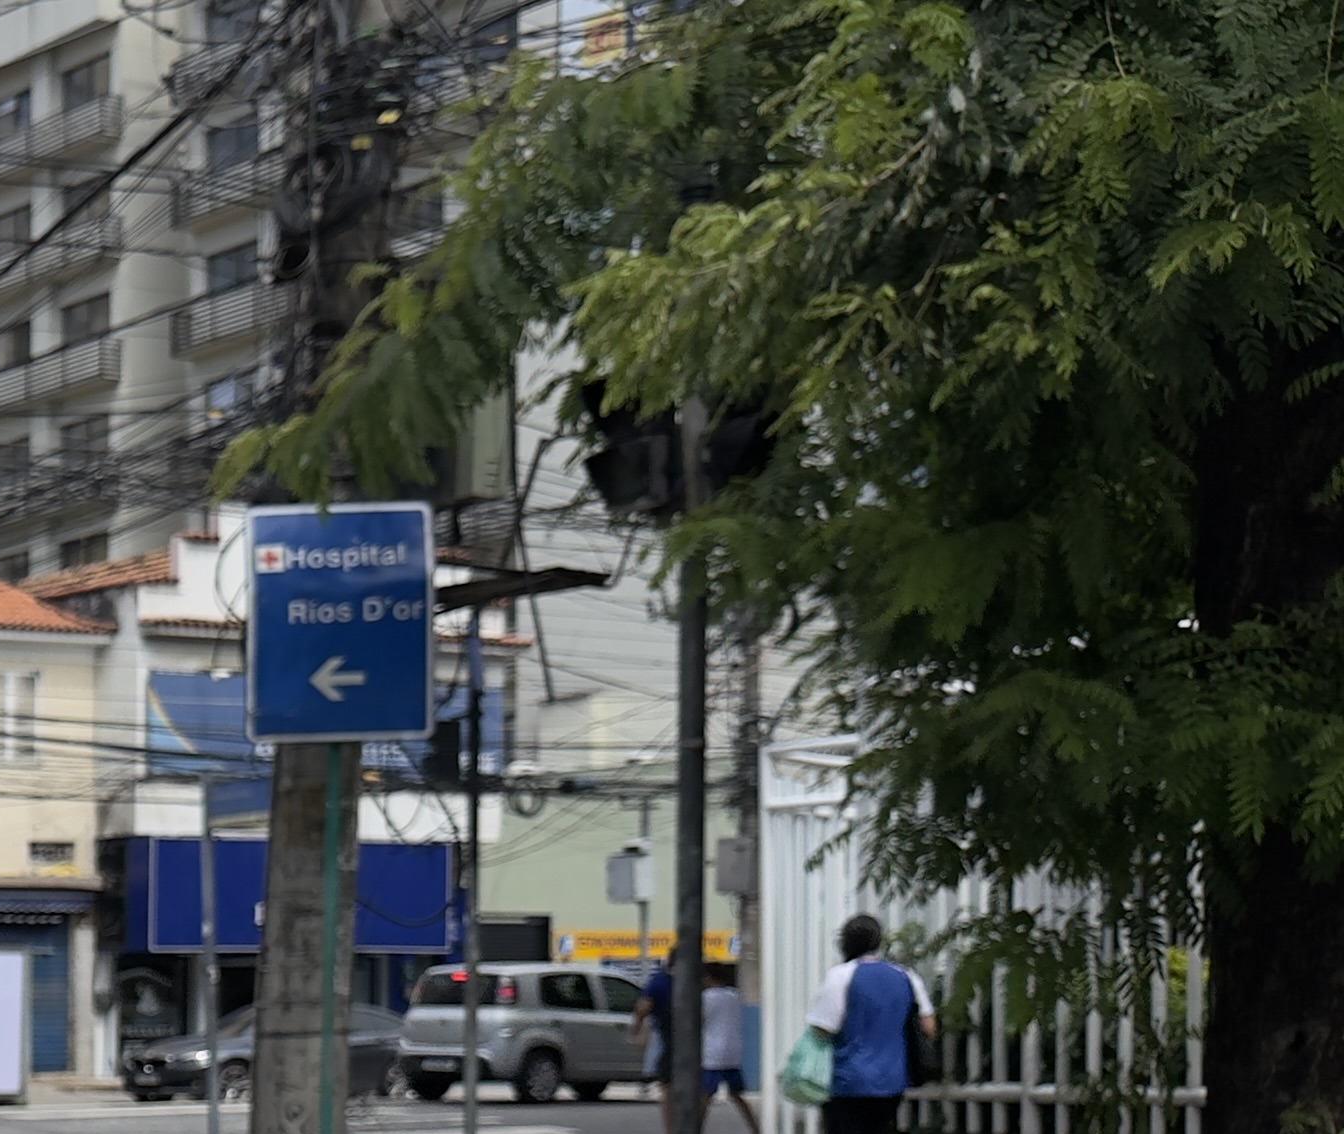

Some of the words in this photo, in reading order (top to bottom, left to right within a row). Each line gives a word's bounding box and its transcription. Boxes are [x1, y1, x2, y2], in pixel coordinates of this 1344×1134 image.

[286, 540, 406, 571] Hospital
[288, 598, 353, 624] Rios
[363, 596, 424, 622] D'or
